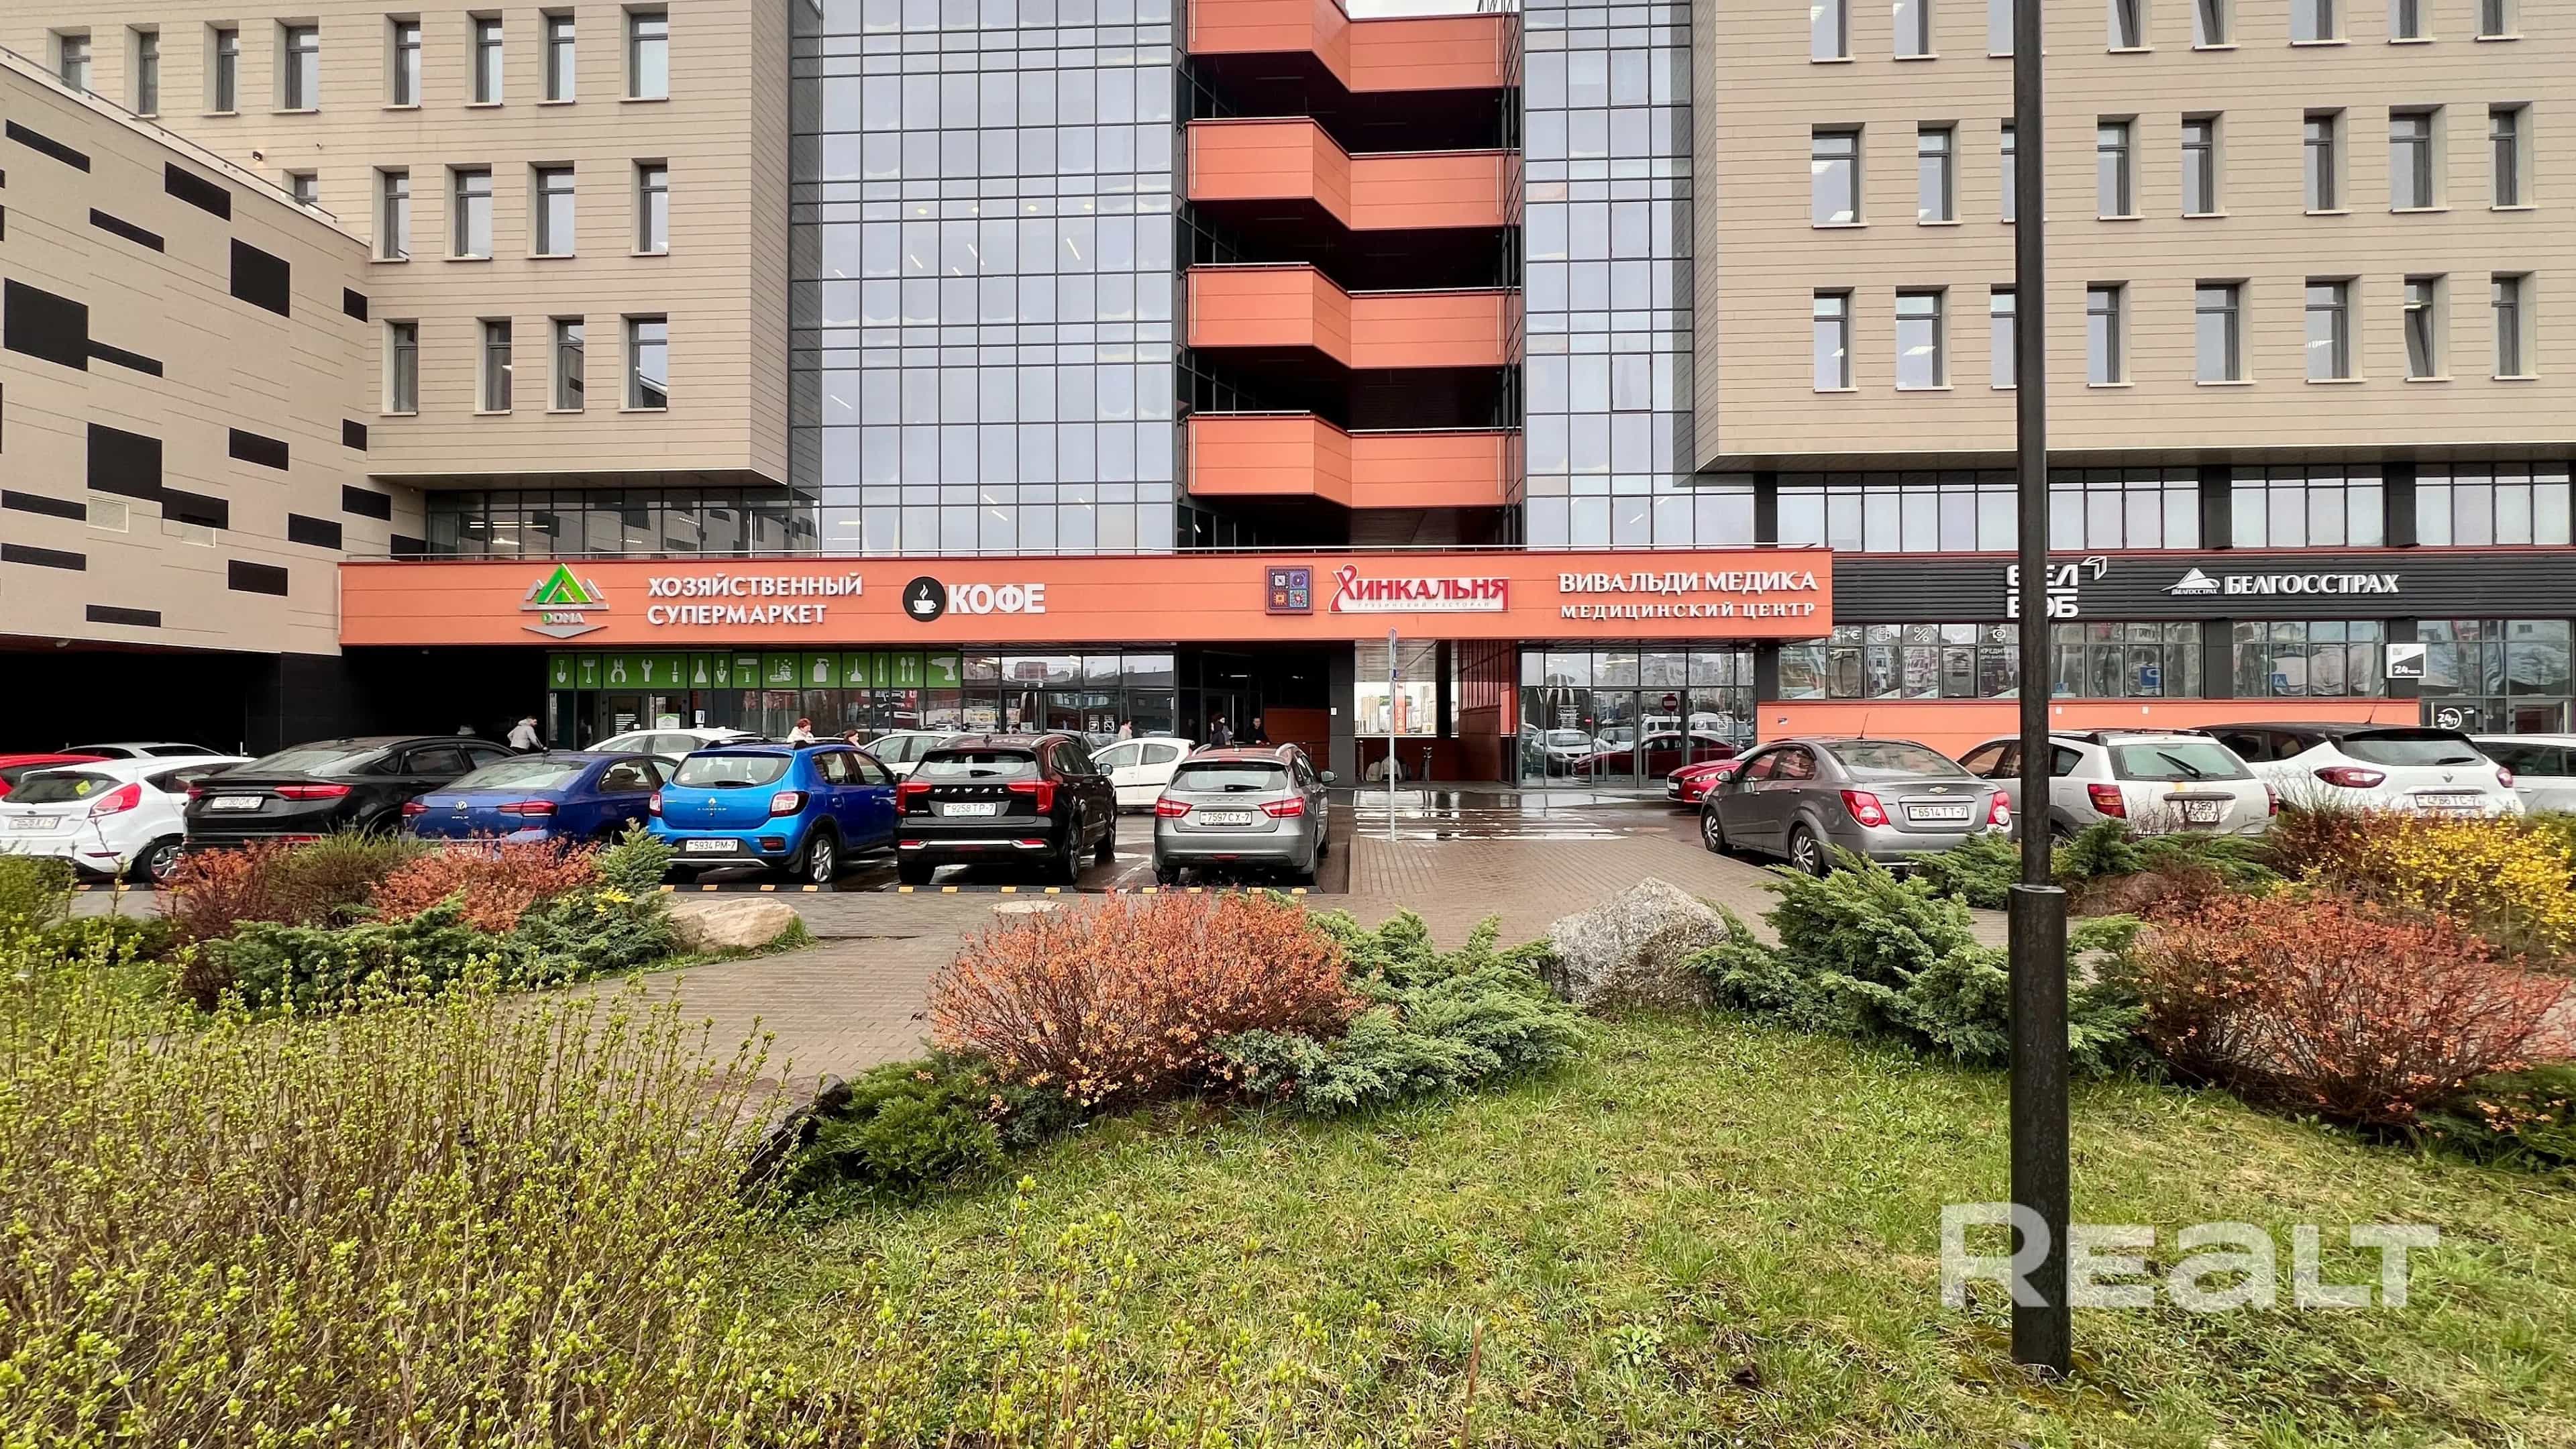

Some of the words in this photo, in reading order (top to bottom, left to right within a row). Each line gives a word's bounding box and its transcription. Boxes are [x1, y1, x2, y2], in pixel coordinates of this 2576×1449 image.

[647, 572, 863, 597] ХОЗЯЙСТВЕННЫЙ
[1331, 565, 1509, 612] ХИНКАЛЬНЯ
[1558, 572, 1701, 596] ВИВАЛЬДИ
[1705, 571, 1819, 593] МЕДИКА
[2224, 574, 2400, 595] БЕЛГОССТРАХ
[949, 582, 1046, 614] КОФЕ
[647, 605, 827, 625] СУПЕРМАРКЕТ
[1561, 602, 1735, 620] МЕДИЦИНСКИЙ
[1743, 602, 1816, 620] ЦЕНТР
[1208, 813, 1226, 822] 7597
[694, 841, 713, 849] 5934
